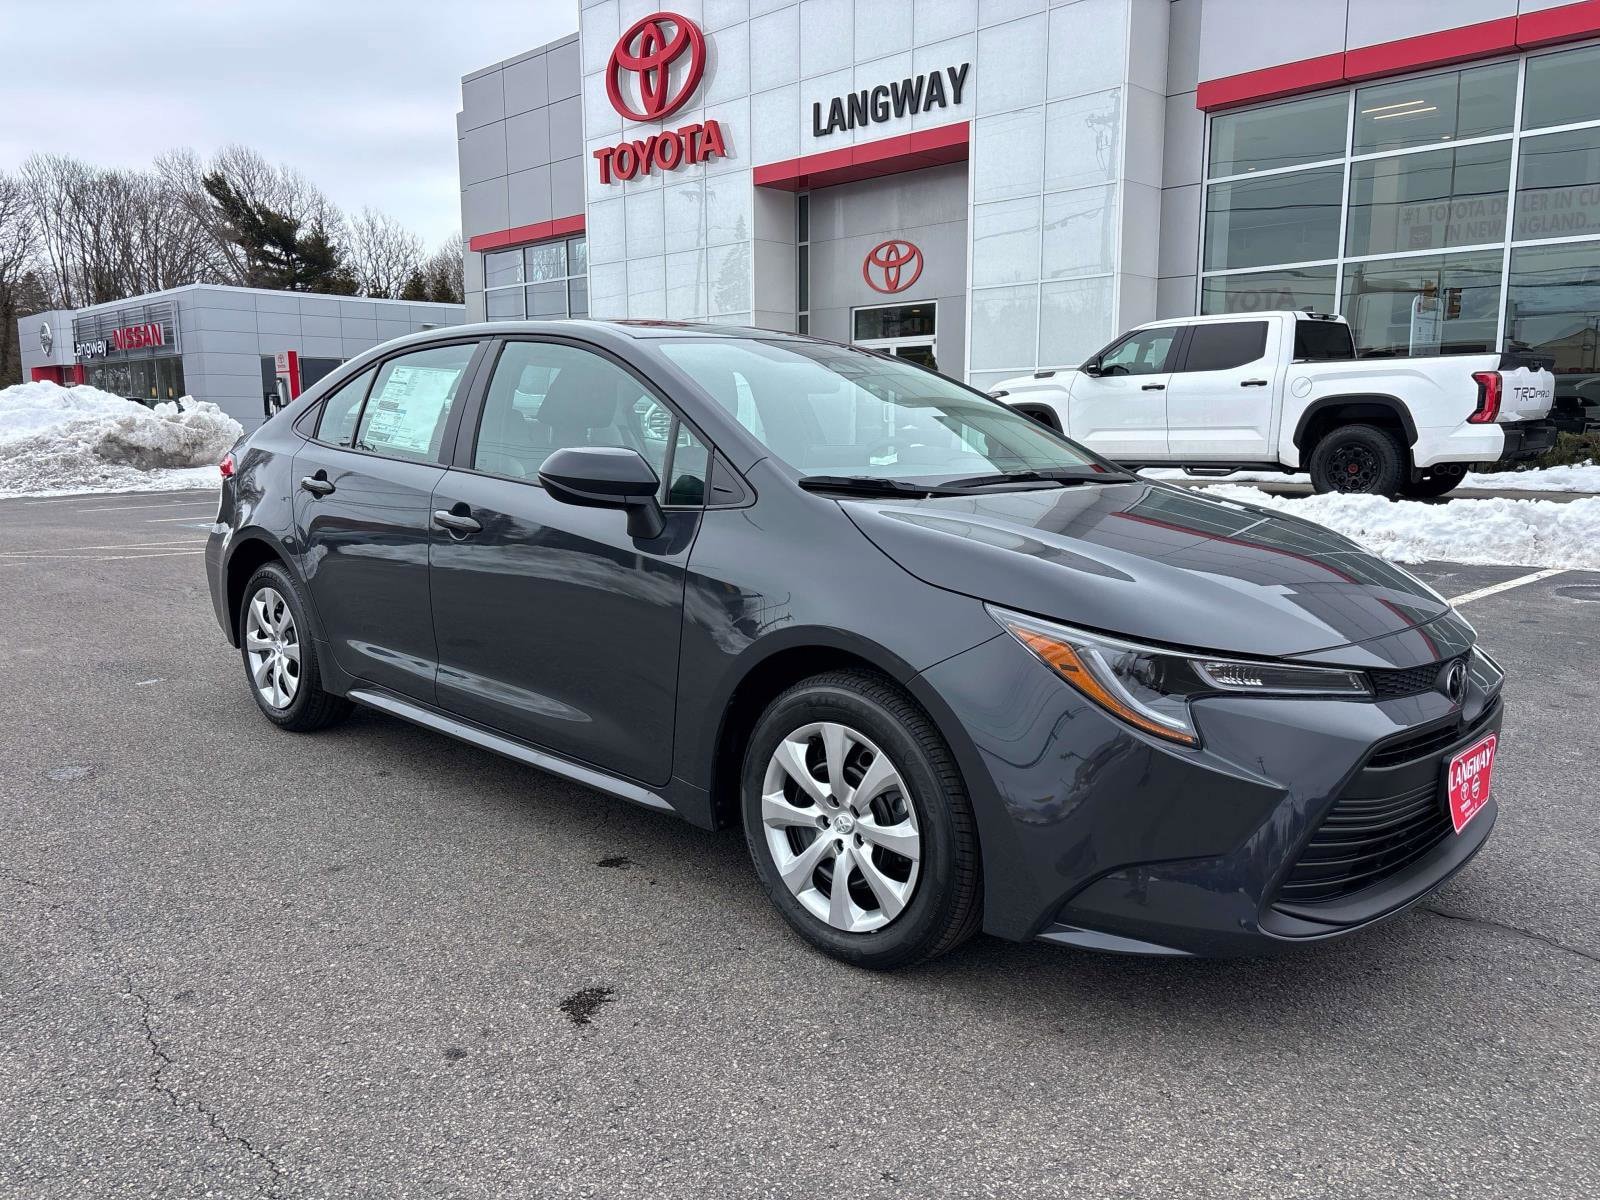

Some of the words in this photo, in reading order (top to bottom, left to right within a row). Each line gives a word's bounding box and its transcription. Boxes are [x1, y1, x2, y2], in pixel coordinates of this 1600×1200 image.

[813, 63, 970, 137] LANGWAY
[593, 120, 726, 184] TOYOTA
[1427, 201, 1486, 224] TOYOTA
[1491, 192, 1548, 217] DLER
[1554, 190, 1573, 209] IN
[1466, 221, 1502, 239] NEW
[1519, 211, 1600, 235] NGLAND...
[1225, 287, 1296, 312] YOTA
[73, 340, 108, 358] Langway
[112, 323, 163, 349] NISSAN
[1451, 747, 1493, 791] LANGWAY
